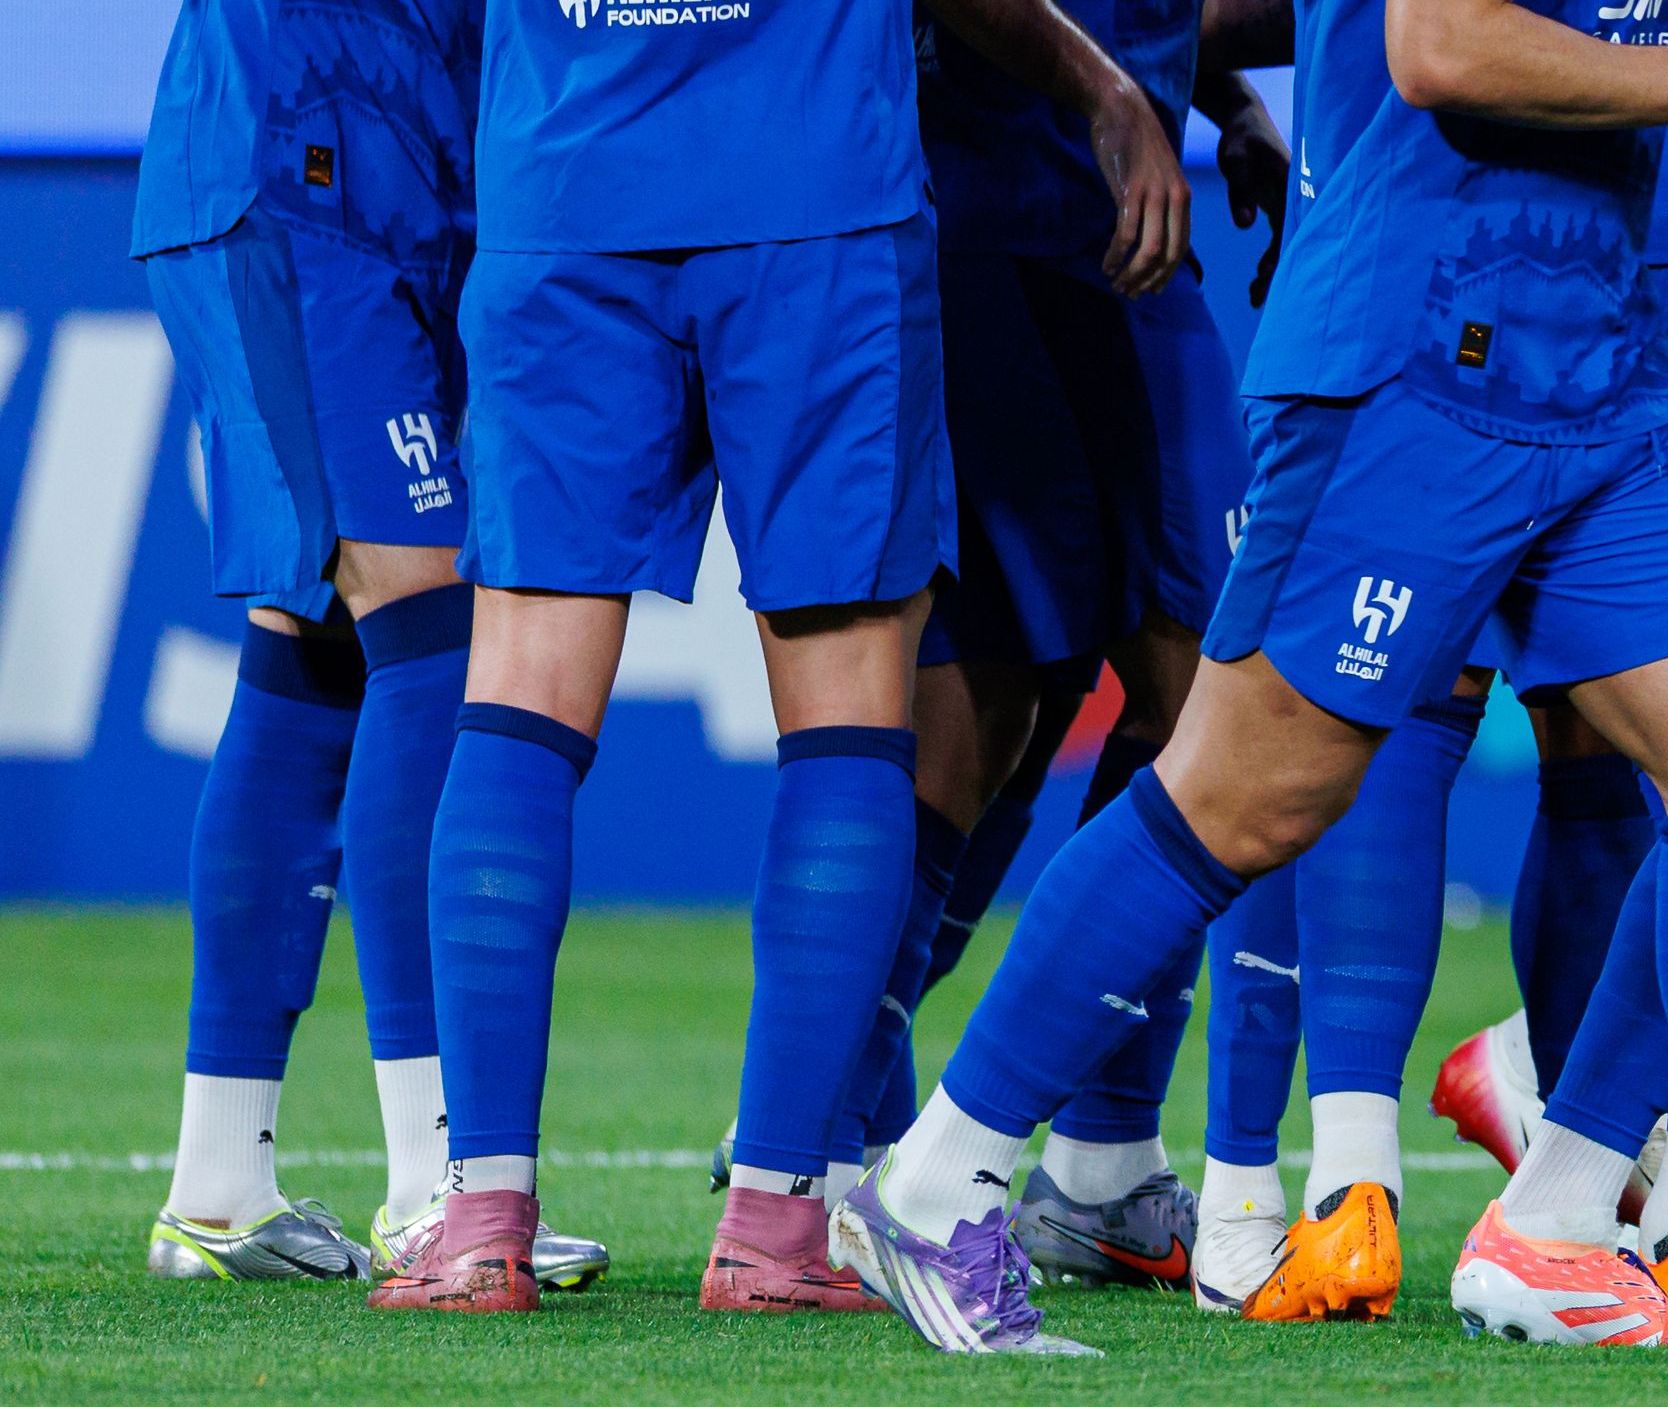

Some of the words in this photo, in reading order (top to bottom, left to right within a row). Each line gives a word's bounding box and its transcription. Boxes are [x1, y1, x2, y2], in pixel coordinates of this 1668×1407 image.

[607, 2, 750, 27] FOUNDATION
[408, 476, 450, 499] ALHILAL
[413, 491, 453, 514] الهلال
[1338, 642, 1389, 667] ALHILAL
[1335, 659, 1384, 681] الهلال
